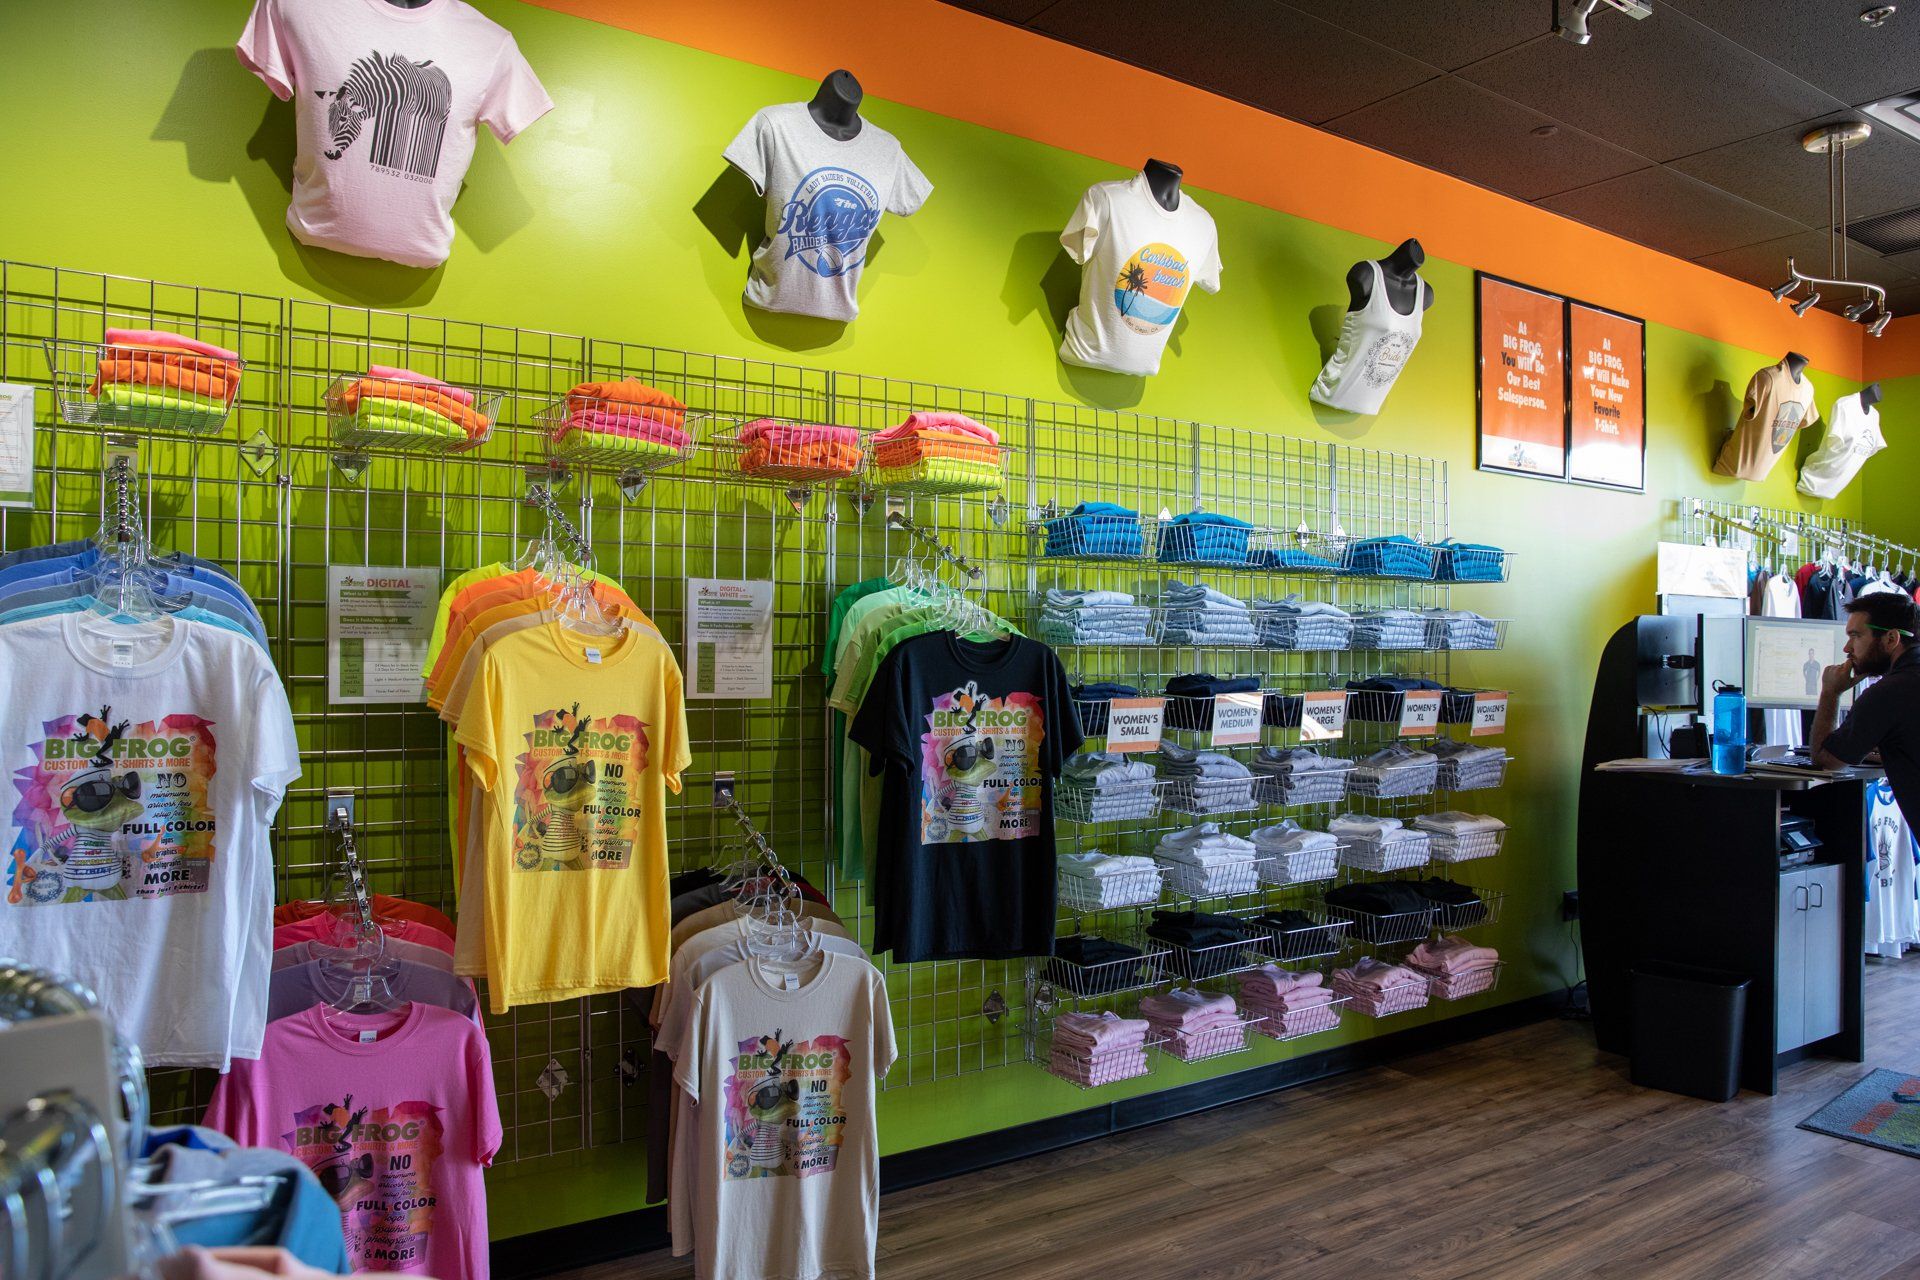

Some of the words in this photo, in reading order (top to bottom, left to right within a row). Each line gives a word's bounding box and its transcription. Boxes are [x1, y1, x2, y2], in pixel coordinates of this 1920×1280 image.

[370, 165, 401, 177] 789532
[404, 173, 434, 184] 032000
[806, 178, 821, 194] LADY
[791, 235, 828, 253] RAIDERS
[1517, 321, 1528, 336] At
[1503, 334, 1518, 350] BIG
[1602, 338, 1611, 351] At
[1501, 351, 1516, 367] You
[1535, 359, 1545, 375] Be
[1588, 350, 1602, 365] BIG
[1506, 371, 1520, 387] Our
[1523, 374, 1541, 391] Best
[1611, 371, 1630, 389] Make
[1497, 387, 1547, 410] Salesperson.
[1590, 384, 1607, 399] Your
[1608, 387, 1623, 403] New
[1593, 401, 1621, 418] Favorite
[367, 578, 412, 588] DIGITAL
[1217, 707, 1259, 717] WOMEN'S
[1306, 705, 1342, 715] WOMEN'S
[1406, 703, 1437, 713] WOMEN'S
[1476, 704, 1505, 714] WOMEN'S
[933, 710, 968, 727] BIG
[976, 709, 1027, 727] FROG
[1113, 714, 1159, 725] WOMEN'S
[1220, 718, 1254, 729] MEDIUM
[1312, 715, 1335, 724] ARGE
[1416, 713, 1425, 721] XL
[1484, 714, 1496, 722] 2XL
[934, 728, 962, 736] CUSTOM
[1120, 725, 1150, 736] SMALL
[534, 730, 570, 748] BIG
[578, 731, 631, 752] FROG
[44, 738, 100, 759] BIG
[112, 737, 191, 759] FROG
[533, 748, 563, 757] CUSTOM
[45, 760, 88, 771] CUSTOM
[114, 758, 155, 769] T-SHIRTS
[158, 759, 163, 768] &
[166, 758, 191, 767] MORE
[604, 763, 624, 778] NO
[156, 772, 187, 789] NO
[983, 779, 1010, 788] FULL
[150, 791, 191, 799] minimums
[147, 800, 177, 808] artwork
[175, 800, 192, 809] fees
[605, 805, 642, 818] COLOR
[123, 823, 161, 835] FULL
[166, 820, 216, 832] COLOR
[1000, 817, 1028, 829] MORE
[155, 848, 178, 858] graphics
[144, 870, 191, 885] MORE
[739, 1054, 774, 1070] BIG
[781, 1053, 833, 1069] FROG
[738, 1070, 766, 1078] CUSTOM
[811, 1080, 827, 1092] NO
[786, 1119, 810, 1128] FULL
[814, 1116, 847, 1126] COLOR
[297, 1126, 341, 1146] BIG
[351, 1122, 419, 1142] FROG
[390, 1154, 412, 1170] NO
[794, 1161, 800, 1169] &
[801, 1156, 829, 1170] MORE
[356, 1200, 389, 1211] FULL
[394, 1197, 437, 1210] COLOR
[364, 1248, 372, 1259] &
[374, 1247, 415, 1260] MORE
